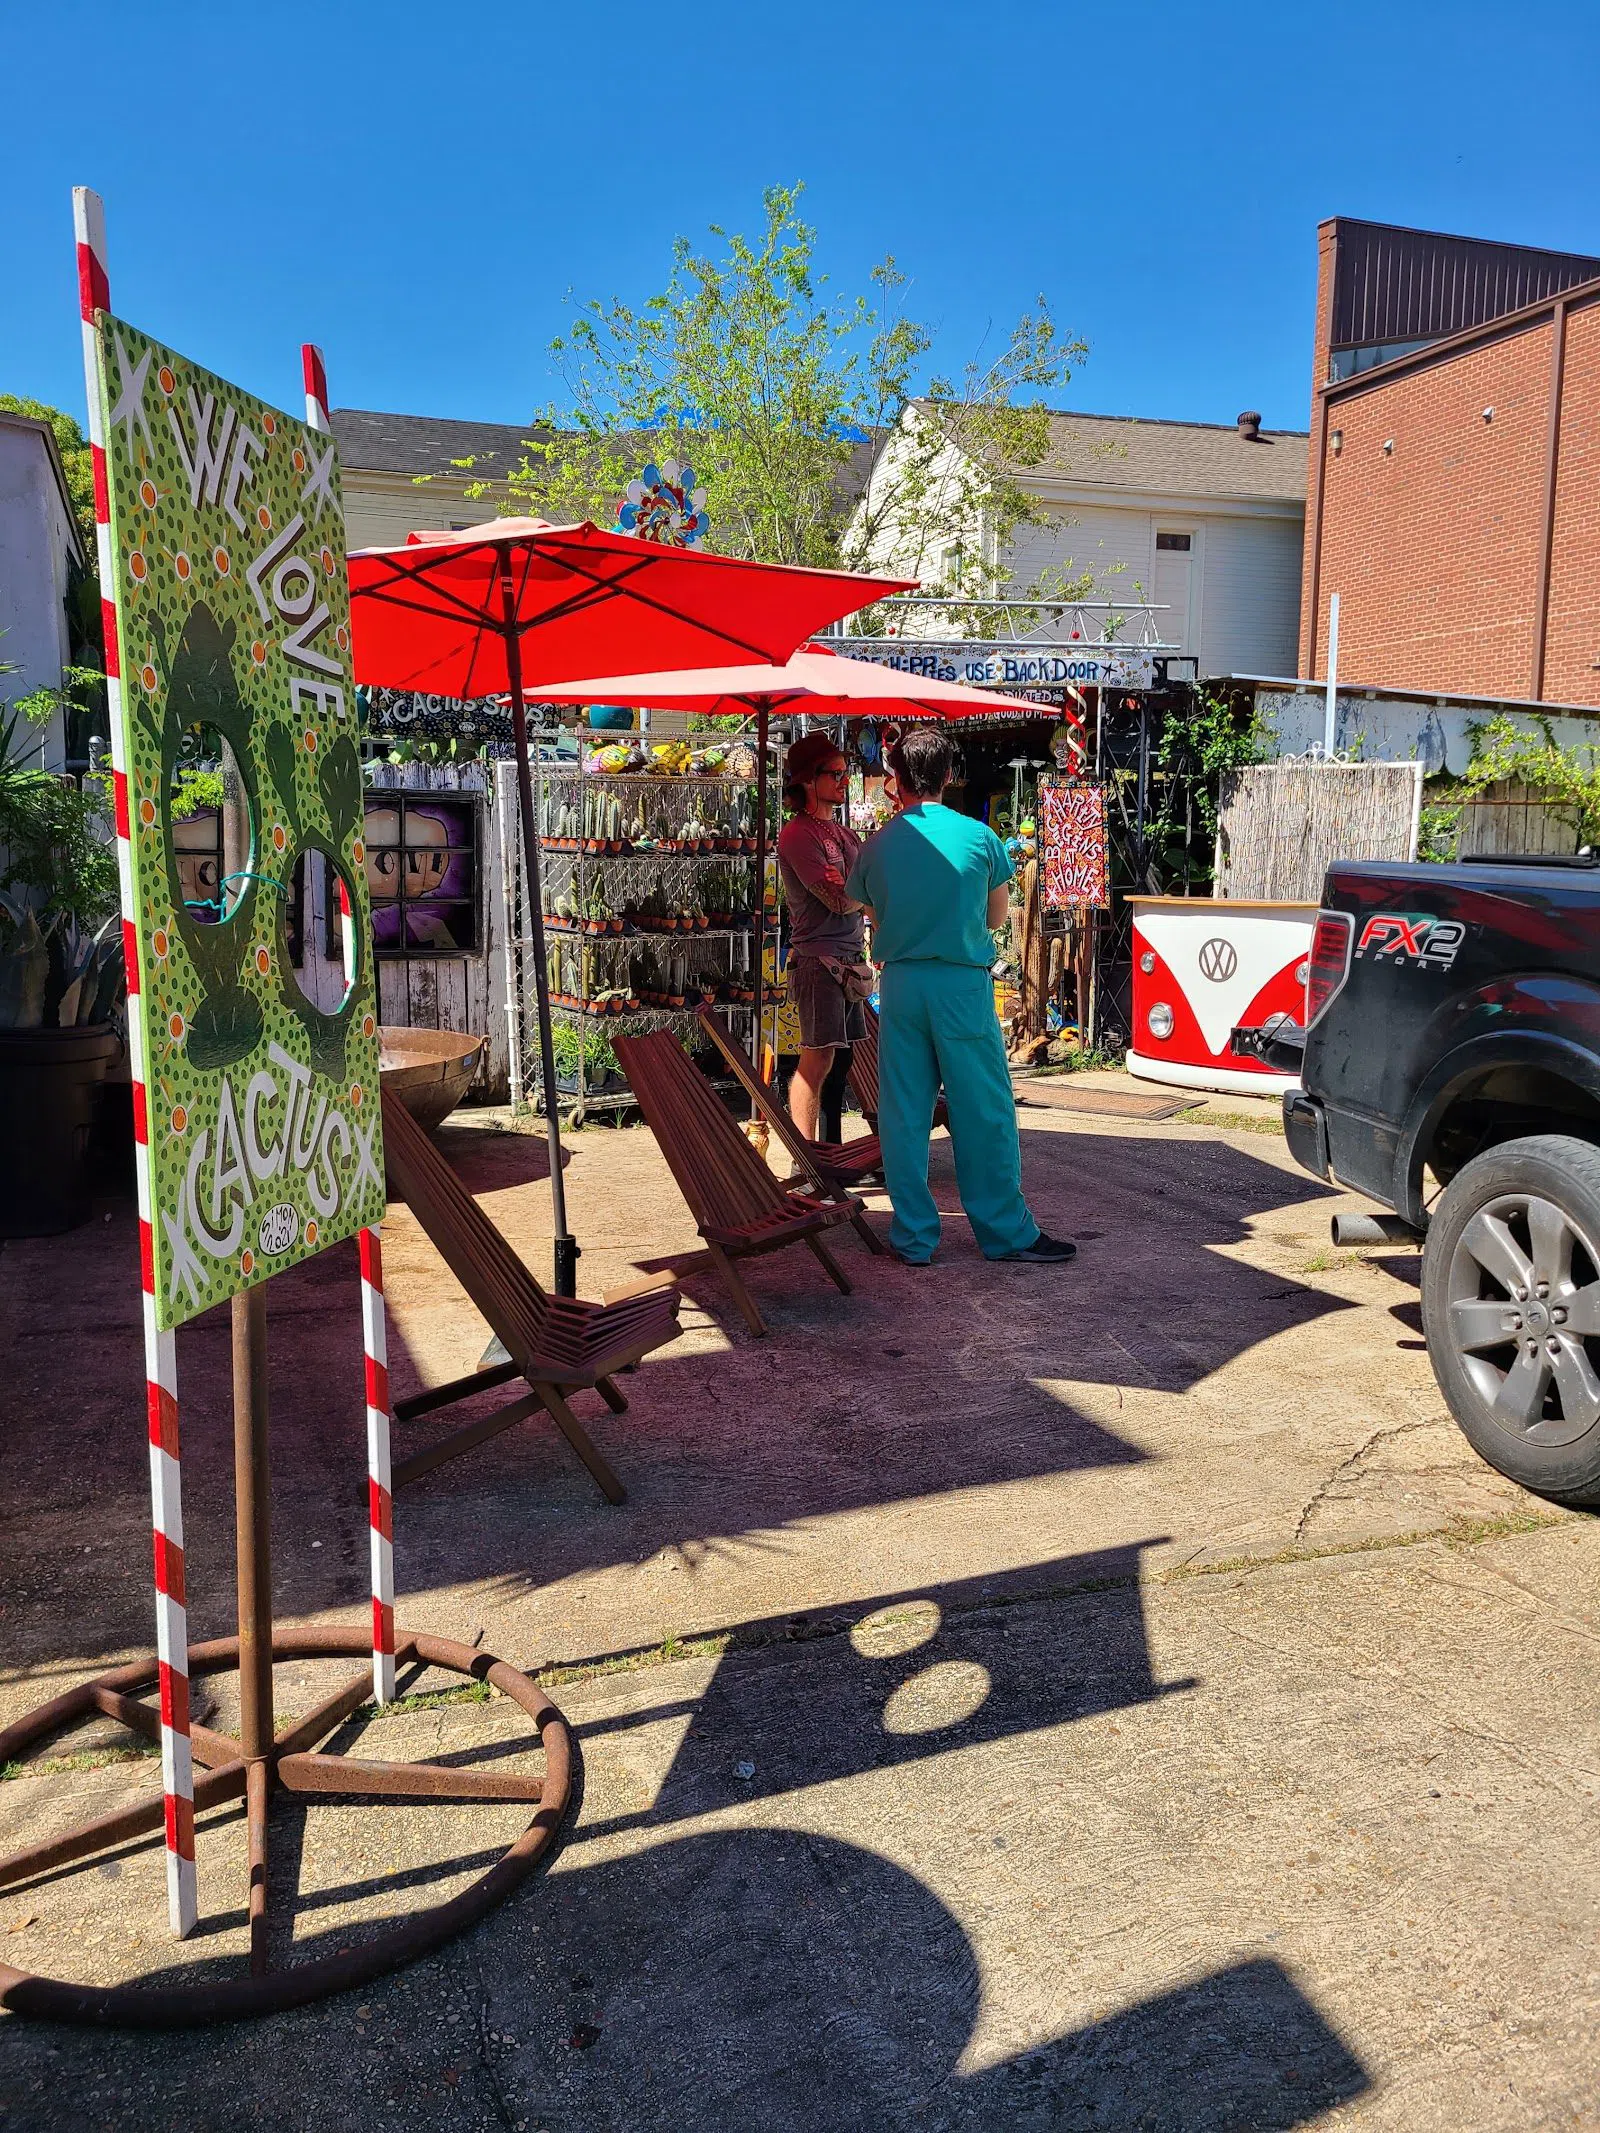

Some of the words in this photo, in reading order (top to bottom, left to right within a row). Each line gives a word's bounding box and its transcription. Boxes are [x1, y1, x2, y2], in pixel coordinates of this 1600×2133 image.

[167, 382, 268, 540] WE
[246, 511, 346, 726] LOVE
[965, 662, 996, 682] USE
[1002, 656, 1050, 682] BACK
[1051, 657, 1100, 682] DOOR
[393, 691, 478, 723] CACTUS
[482, 692, 545, 724] SP
[1064, 848, 1078, 864] AT
[1051, 864, 1100, 893] HOME
[1357, 914, 1467, 964] FX2
[1354, 949, 1452, 972] SPORT
[187, 1041, 352, 1259] CACTUS
